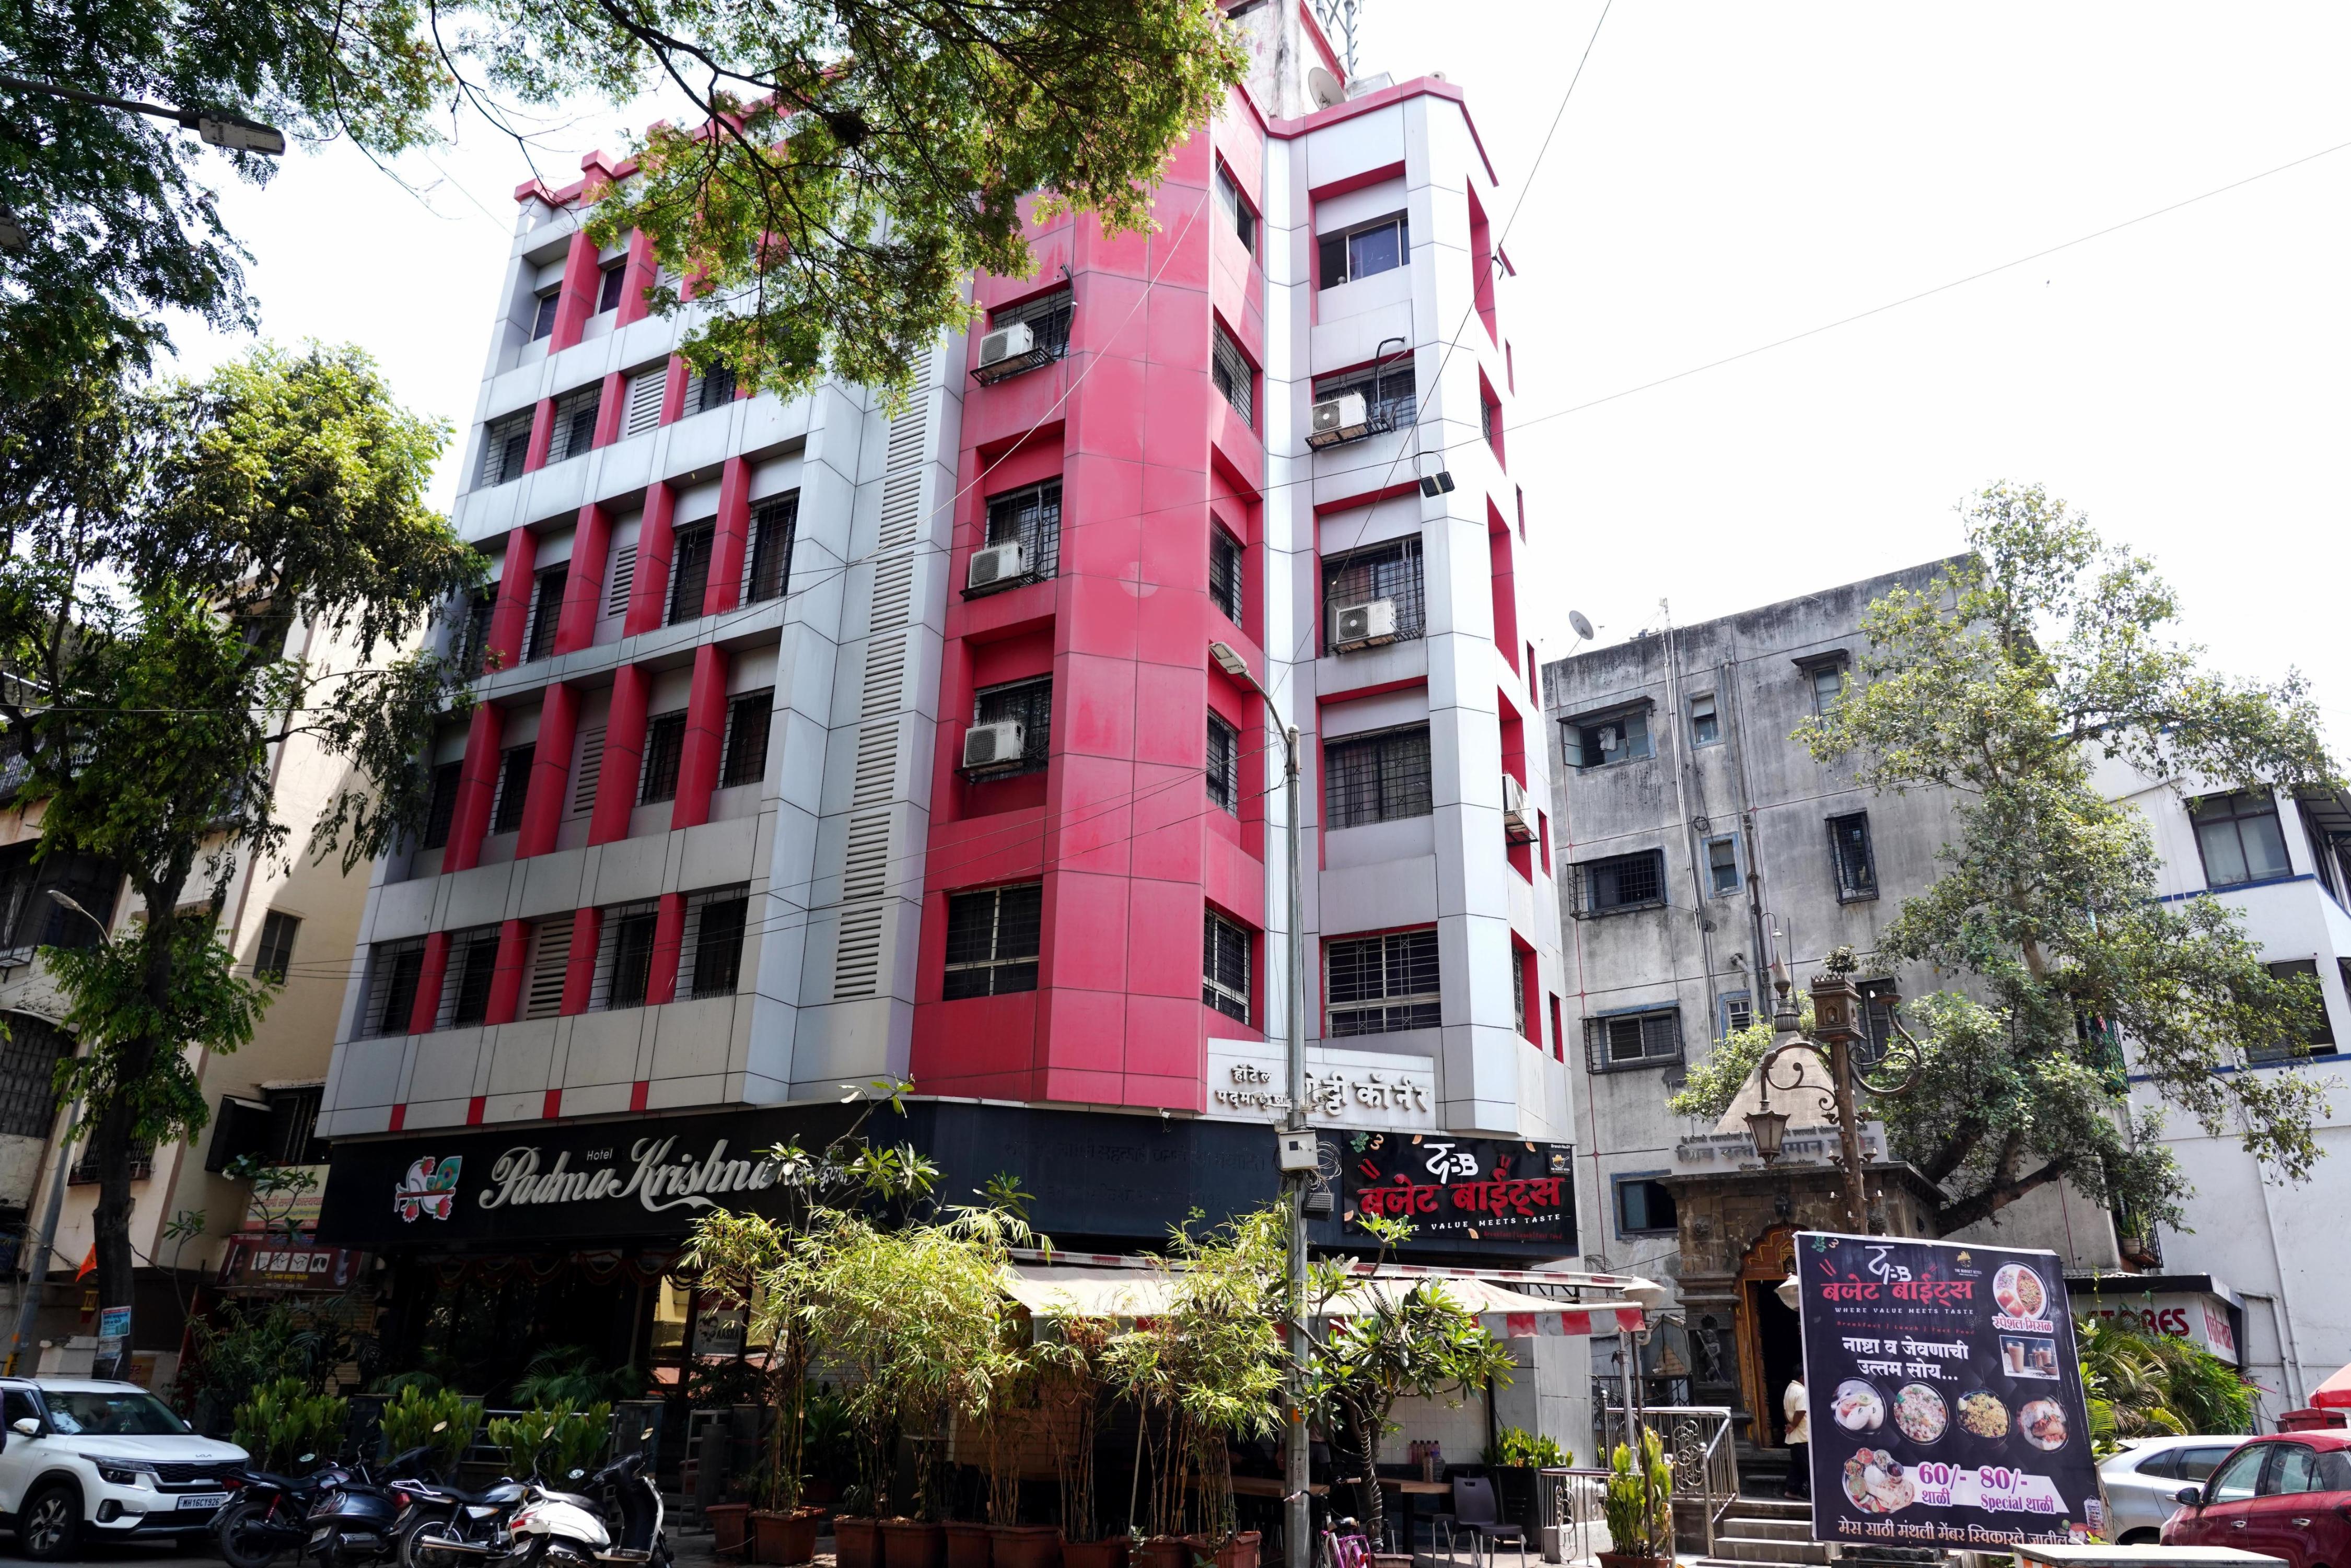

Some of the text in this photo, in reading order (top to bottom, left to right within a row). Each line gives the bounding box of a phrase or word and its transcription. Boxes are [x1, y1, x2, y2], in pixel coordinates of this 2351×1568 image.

[1231, 1063, 1271, 1083] हॉटेल
[1352, 1073, 1430, 1111] कॉर्नर
[587, 1148, 613, 1161] Hotel
[479, 1146, 617, 1209] Padma
[609, 1135, 774, 1212] Krishna
[1357, 1167, 1566, 1218] बजेट बाईट्स
[1431, 1221, 1468, 1230] VALUE
[1479, 1218, 1516, 1227] MEETS
[1524, 1214, 1561, 1224] TASTE
[1820, 1273, 1975, 1306] बजेट बाईट्स
[1993, 1315, 2023, 1330] स्पेशल
[2024, 1317, 2053, 1332] मिसळ
[716, 1328, 739, 1340] AASRA
[1842, 1336, 1969, 1360] नाष्टा व जेवणाची
[1857, 1359, 1902, 1377] उत्तम
[1919, 1464, 2027, 1494] 60/- 80/-
[182, 1497, 220, 1508] MH16CY926
[1922, 1490, 1950, 1505] थाळी
[1981, 1493, 2054, 1513] Special थाळी
[1838, 1516, 1861, 1535] मेस
[1865, 1519, 1895, 1537] साठी
[1897, 1519, 1935, 1540] मंथली
[1937, 1522, 1965, 1541] मेंबर
[1968, 1524, 2026, 1544] स्विकारले
